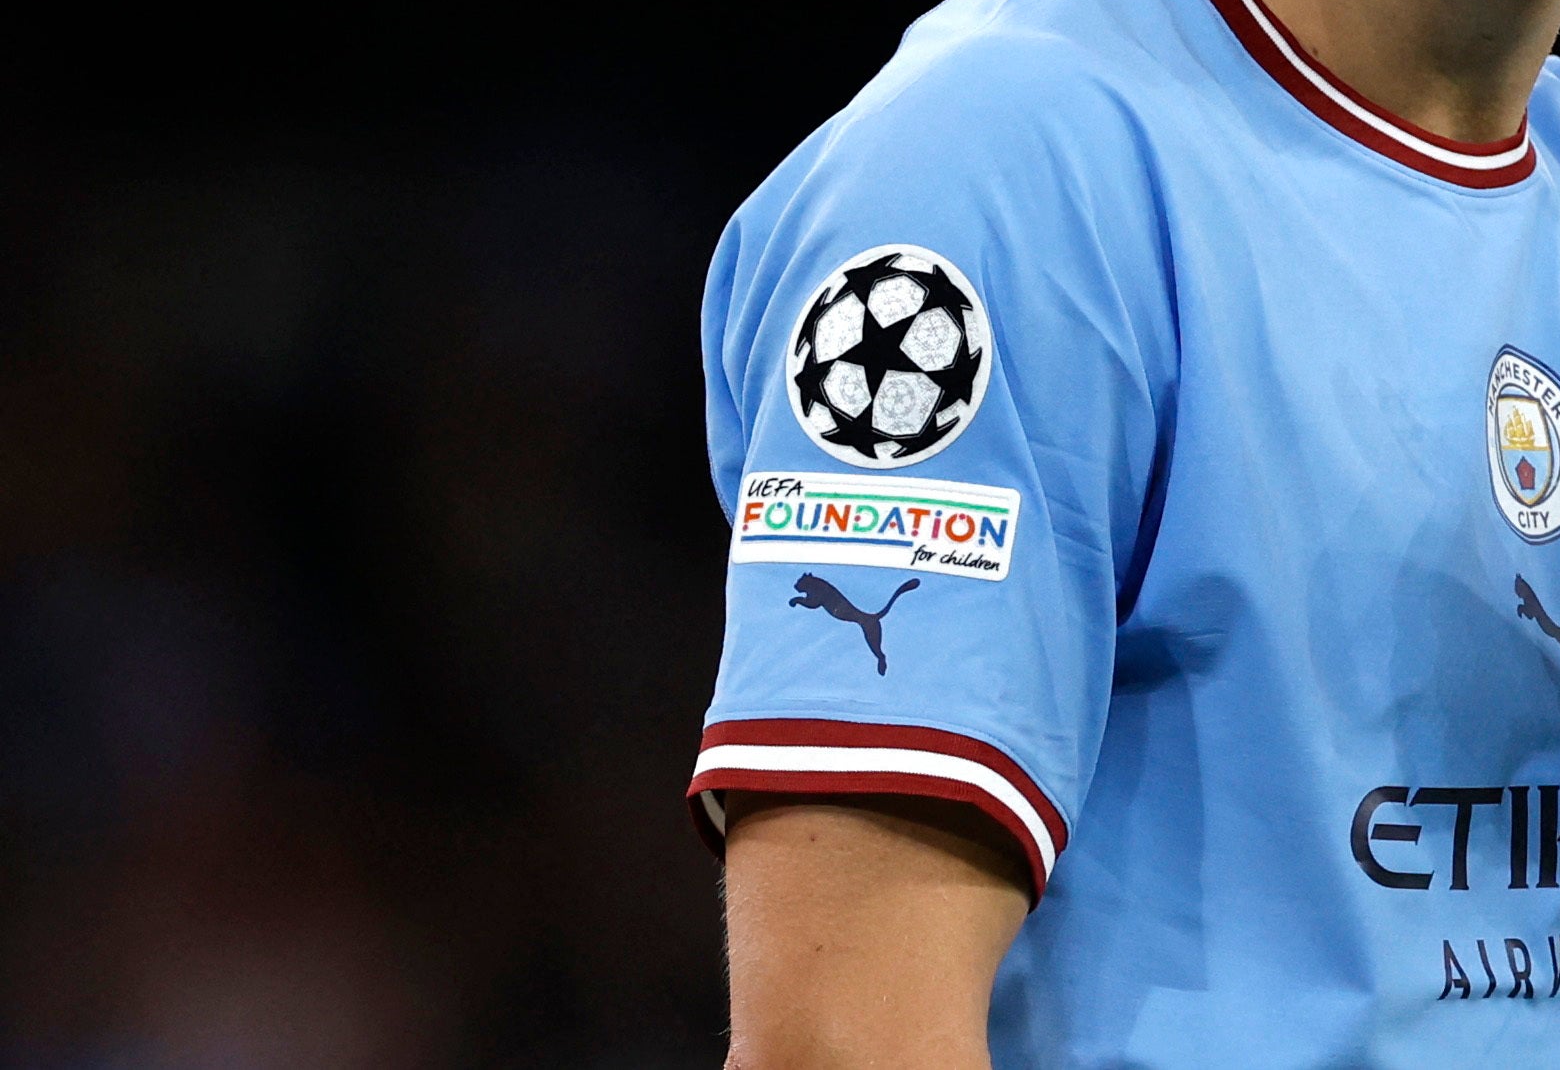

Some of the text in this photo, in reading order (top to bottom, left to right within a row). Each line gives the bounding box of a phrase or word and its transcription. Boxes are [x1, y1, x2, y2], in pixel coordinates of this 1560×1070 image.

[747, 478, 803, 497] UEFA
[742, 501, 1007, 548] FOUNDATION
[1518, 511, 1550, 529] CITY
[910, 545, 1000, 572] for children
